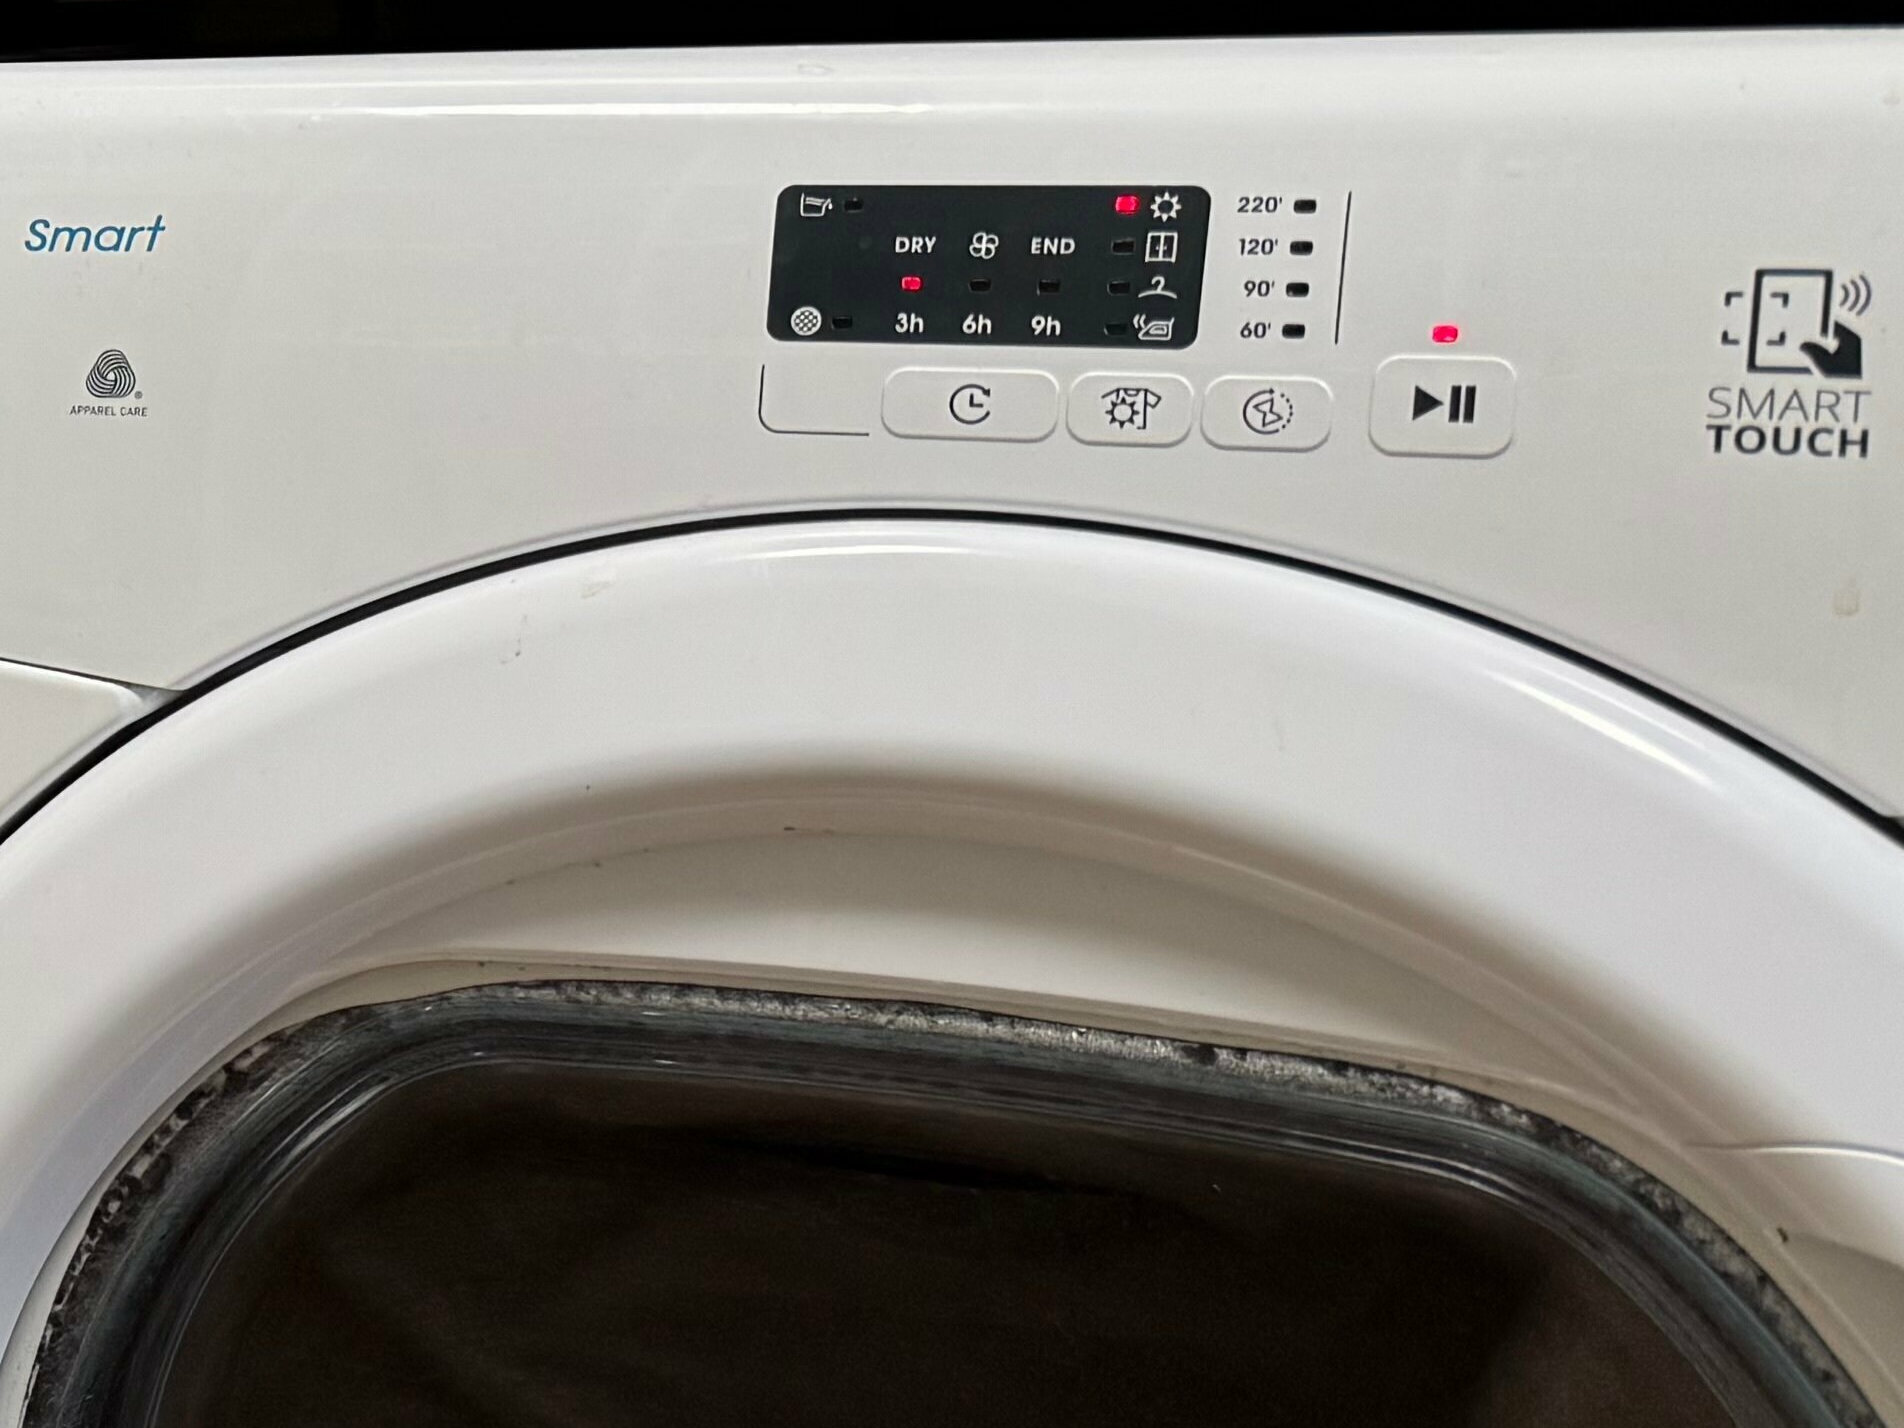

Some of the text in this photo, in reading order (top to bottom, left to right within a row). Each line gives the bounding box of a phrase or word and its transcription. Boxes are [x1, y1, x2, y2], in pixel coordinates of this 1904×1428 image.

[24, 214, 166, 255] Smart
[895, 236, 936, 254] DRY
[1031, 236, 1076, 255] END
[895, 312, 924, 334] 3h
[962, 313, 992, 335] 6h
[1030, 315, 1061, 337] 9h
[69, 405, 148, 417] APPAREL CARE
[1706, 386, 1872, 423] SMART
[1706, 424, 1869, 458] TOUCH
